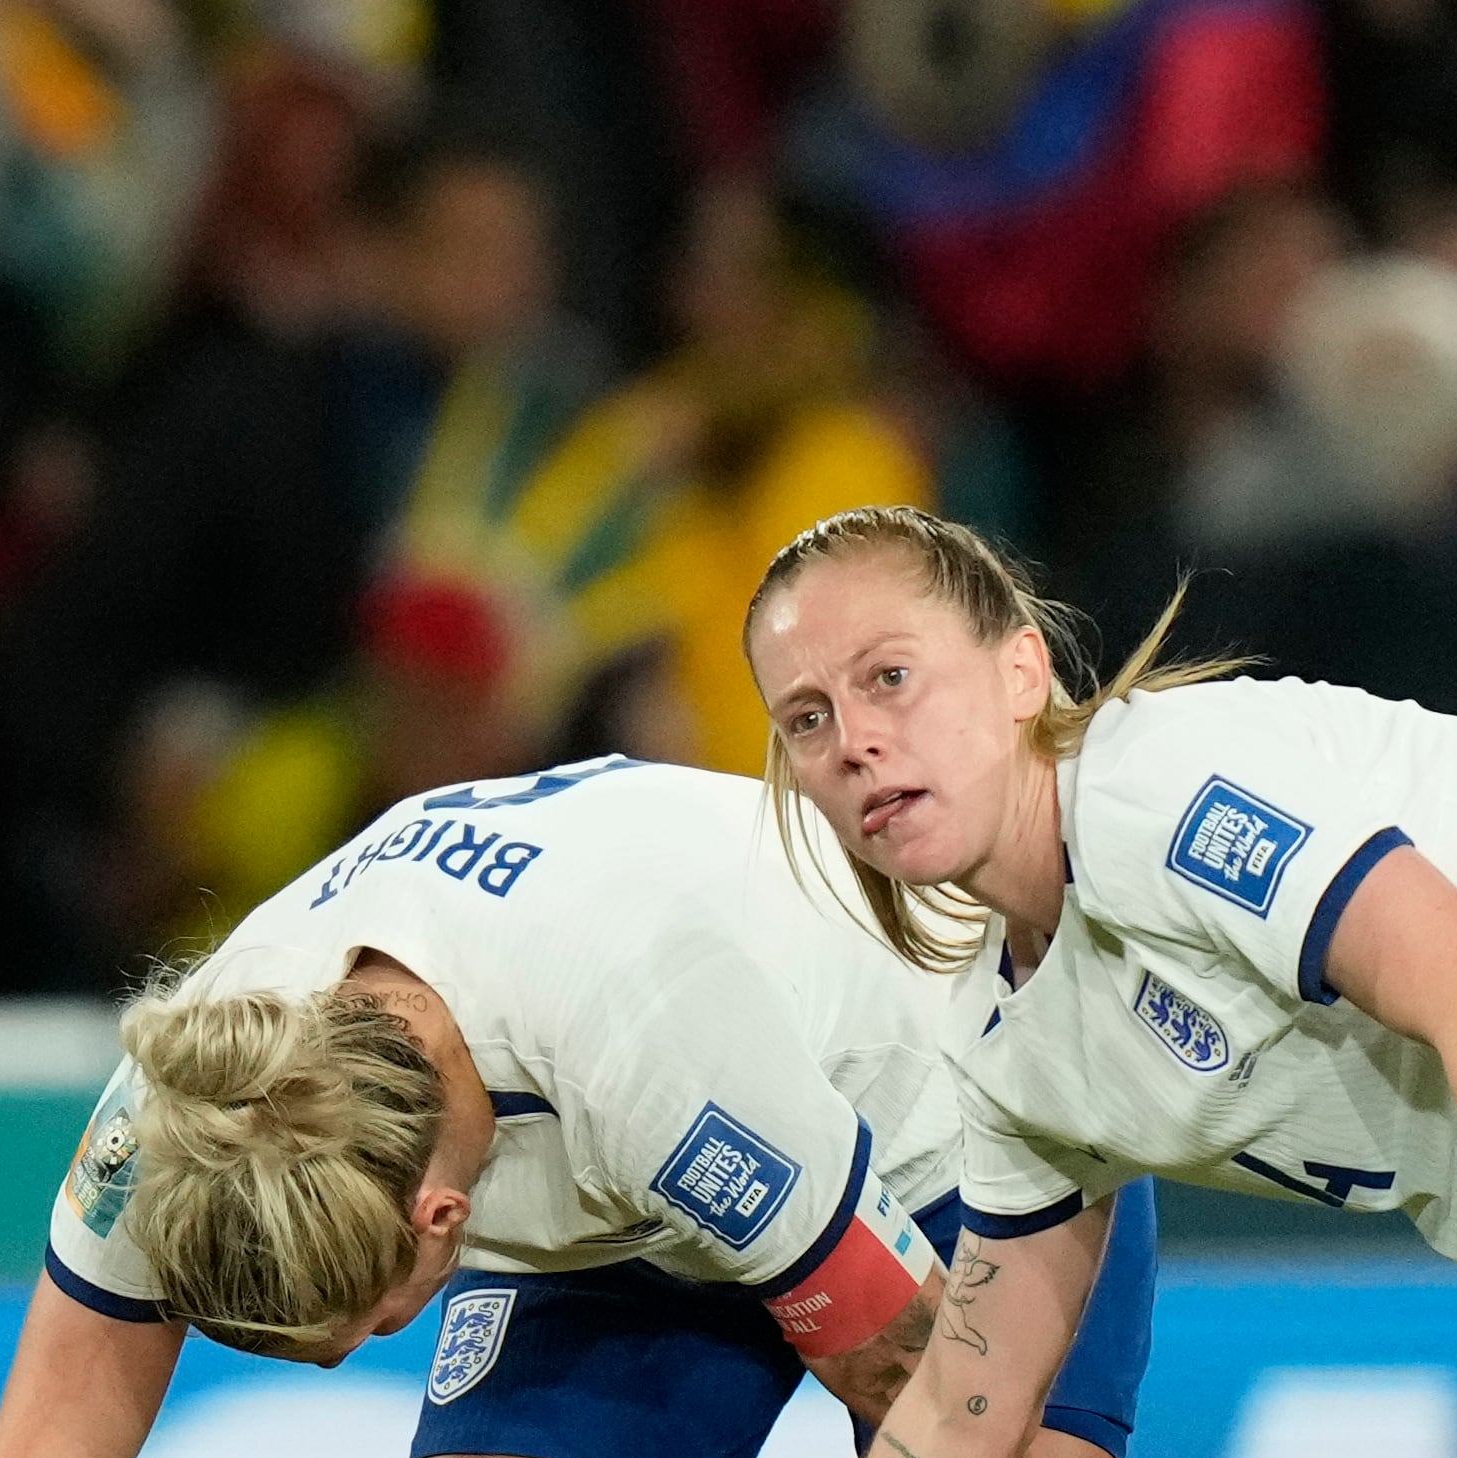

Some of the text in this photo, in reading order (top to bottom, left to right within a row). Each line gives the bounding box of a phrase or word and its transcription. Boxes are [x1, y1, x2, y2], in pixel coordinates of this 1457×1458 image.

[1188, 802, 1231, 860] FOOTBALL
[1203, 808, 1248, 869] UNITES
[1252, 845, 1270, 869] FIFA
[309, 819, 544, 910] BRIGHT
[1223, 856, 1242, 881] the
[677, 1136, 725, 1191] FOOTBALL
[690, 1144, 743, 1204] UNITES
[710, 1153, 761, 1217] the World
[742, 1187, 762, 1211] FIFA
